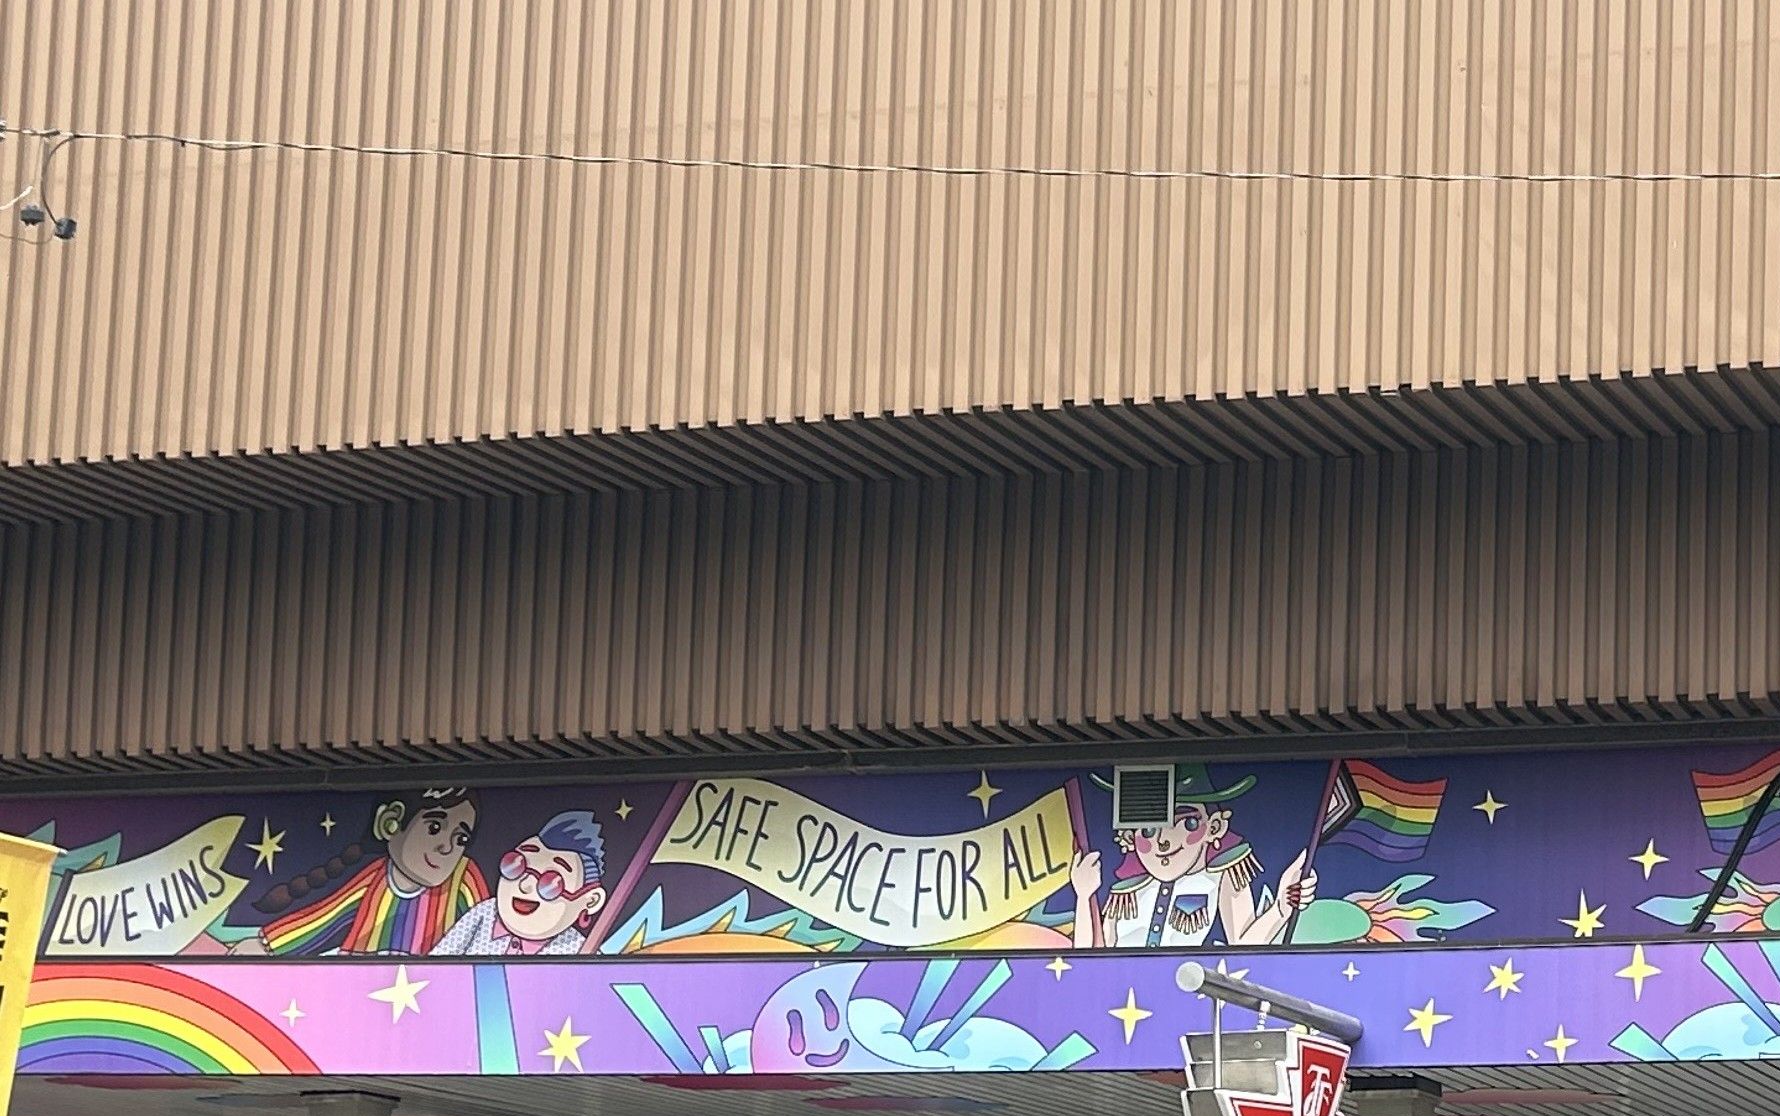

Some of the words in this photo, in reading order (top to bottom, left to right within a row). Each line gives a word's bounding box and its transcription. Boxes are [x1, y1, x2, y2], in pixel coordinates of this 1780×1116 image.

[58, 886, 142, 948] LOVE
[145, 845, 226, 930] WINS
[669, 781, 779, 872] SAFE
[778, 814, 906, 927] SPACE
[912, 840, 988, 928] FOR
[1003, 813, 1068, 900] ALL
